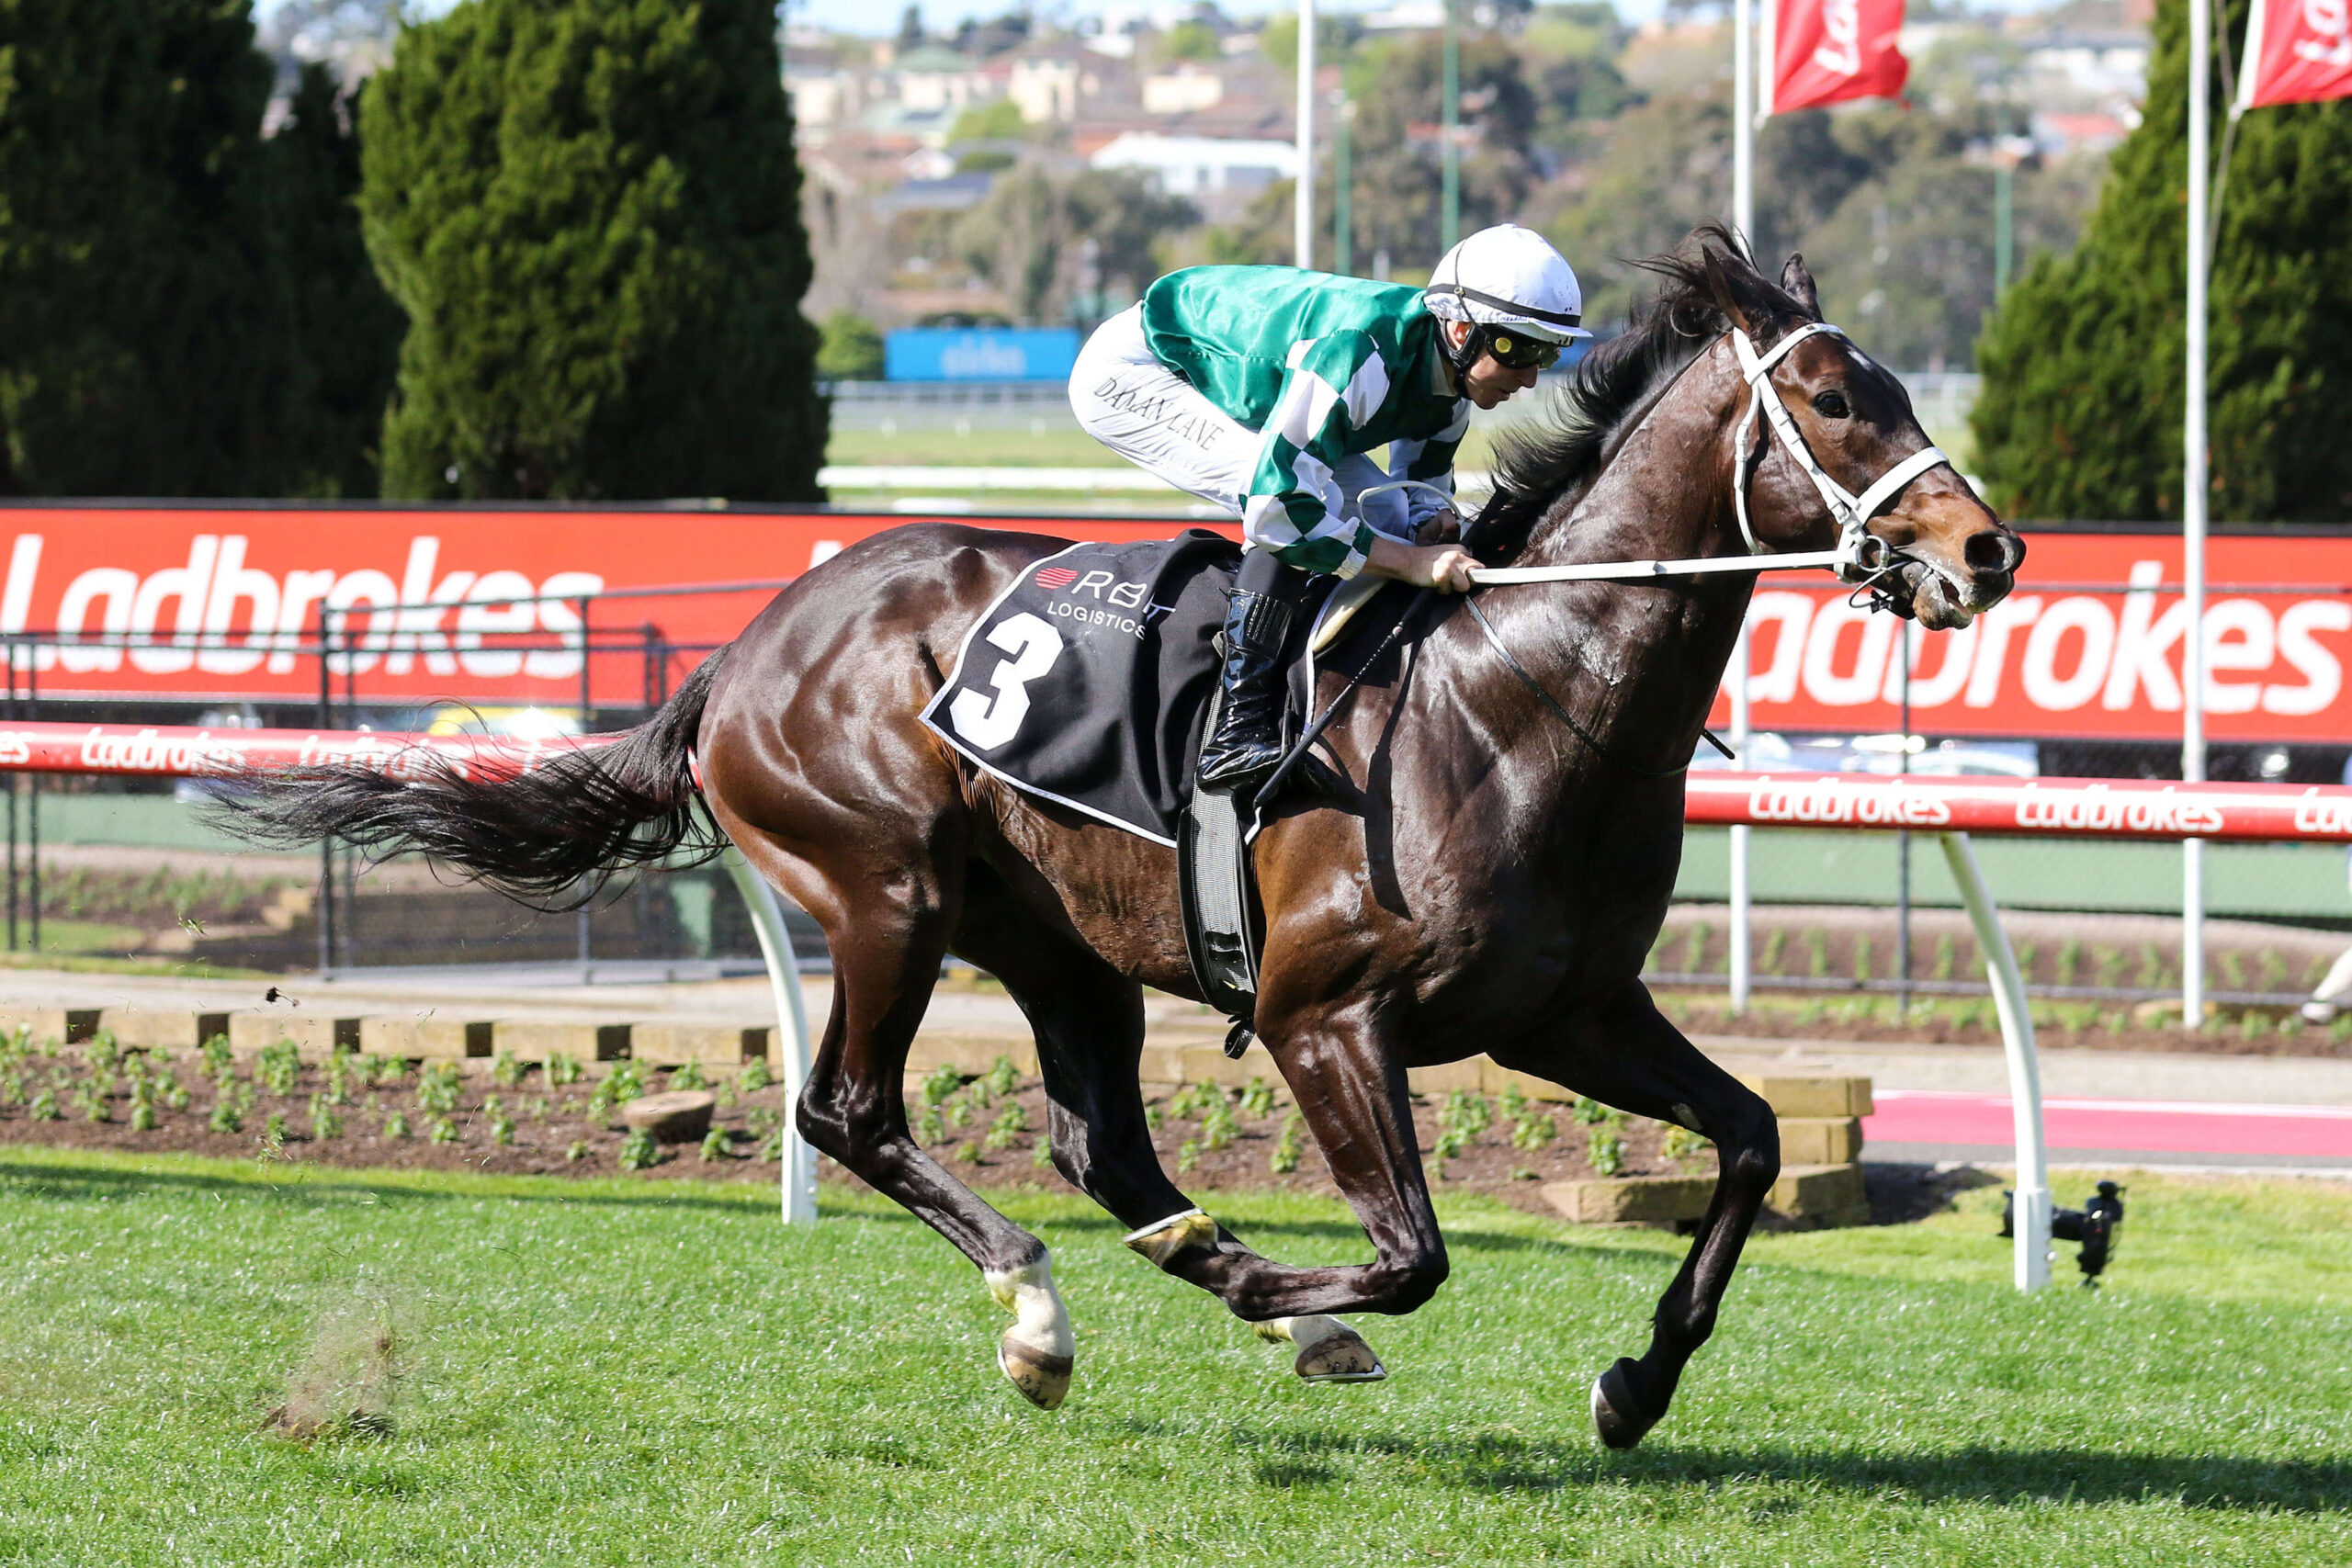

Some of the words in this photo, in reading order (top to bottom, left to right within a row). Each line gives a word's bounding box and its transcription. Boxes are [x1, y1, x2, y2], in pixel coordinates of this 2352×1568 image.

[1166, 408, 1225, 451] LANE
[0, 533, 605, 680] Ladbrokes
[1046, 601, 1147, 640] LOGISTICS
[1720, 560, 2351, 716] adbrokes
[949, 612, 1065, 751] 3
[1748, 775, 1951, 825] Ladbrokes
[2016, 783, 2223, 833] Ladbrokes
